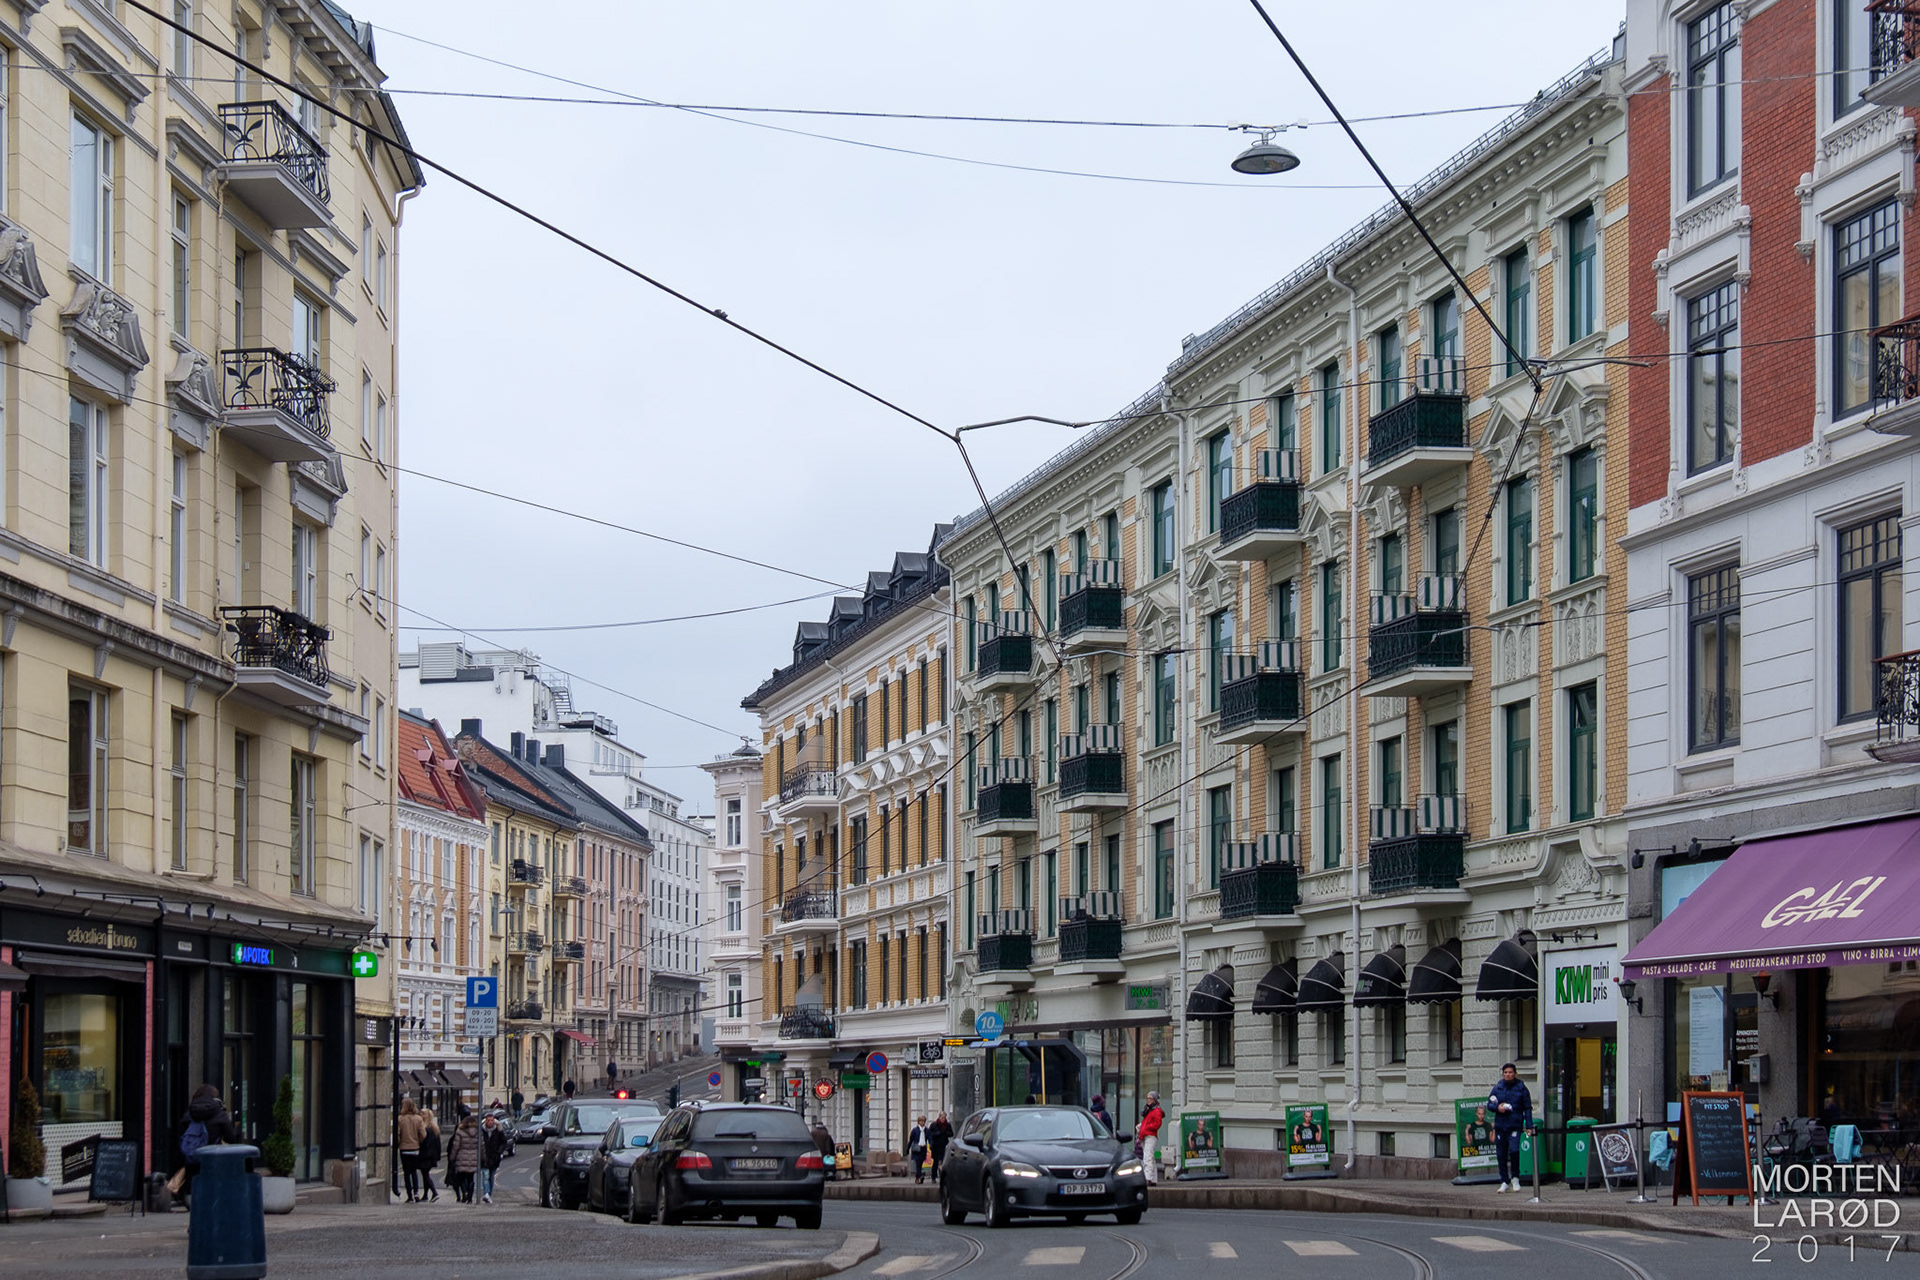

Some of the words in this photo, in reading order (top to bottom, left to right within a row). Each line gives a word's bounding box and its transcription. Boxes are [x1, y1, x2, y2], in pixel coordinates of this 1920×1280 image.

[1761, 876, 1887, 928] GAEL
[242, 946, 270, 965] APOTEK
[270, 948, 274, 965] 1
[1642, 966, 1661, 975] PASTA
[1667, 963, 1692, 974] SALADE
[1699, 961, 1717, 971] CAFE
[1730, 956, 1790, 969] MEDITERRANEAN
[1792, 955, 1804, 965] PIT
[1807, 953, 1827, 964] STOP
[1842, 950, 1862, 960] VINO
[1870, 949, 1895, 959] BIRRA
[1555, 964, 1592, 1005] KIWI
[1593, 961, 1610, 980] mini
[474, 981, 490, 1004] P
[1131, 986, 1153, 997] KIWI
[1593, 982, 1608, 1004] pris
[981, 1016, 996, 1029] 10
[1186, 1151, 1199, 1159] 15%
[1291, 1145, 1305, 1153] 15%
[1463, 1147, 1478, 1157] 15%
[738, 1159, 749, 1167] HS
[752, 1159, 777, 1168] 96340
[1067, 1185, 1078, 1193] DP
